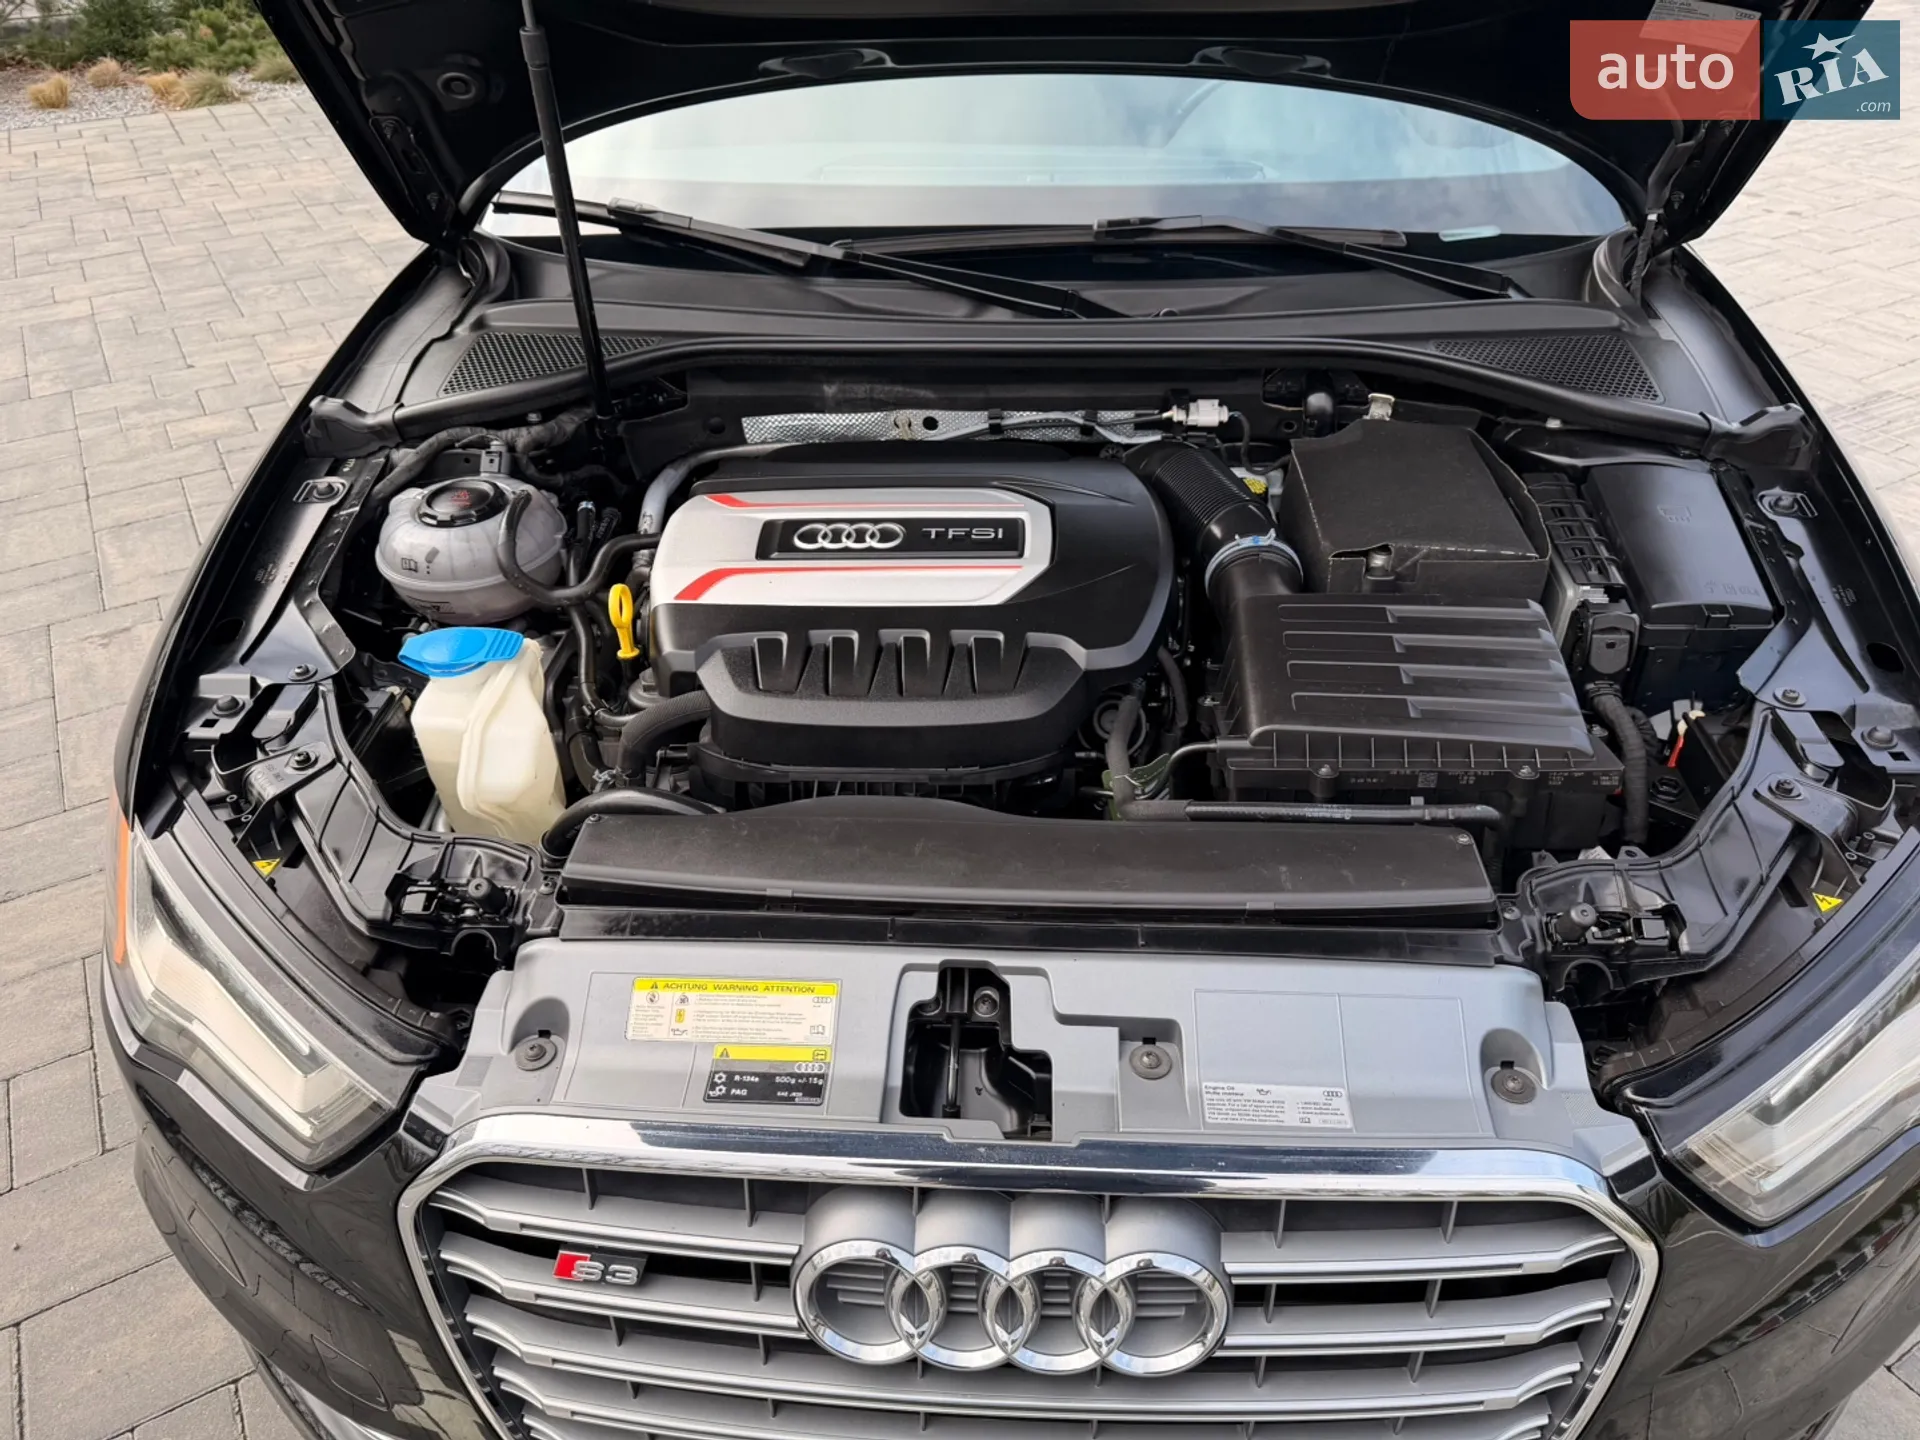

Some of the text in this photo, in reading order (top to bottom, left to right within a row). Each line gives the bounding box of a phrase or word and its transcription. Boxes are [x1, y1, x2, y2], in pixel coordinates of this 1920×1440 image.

[922, 527, 1003, 539] TFSI
[663, 983, 816, 994] ACHTUNG WARNING ATTENTION
[571, 1260, 639, 1286] S3
